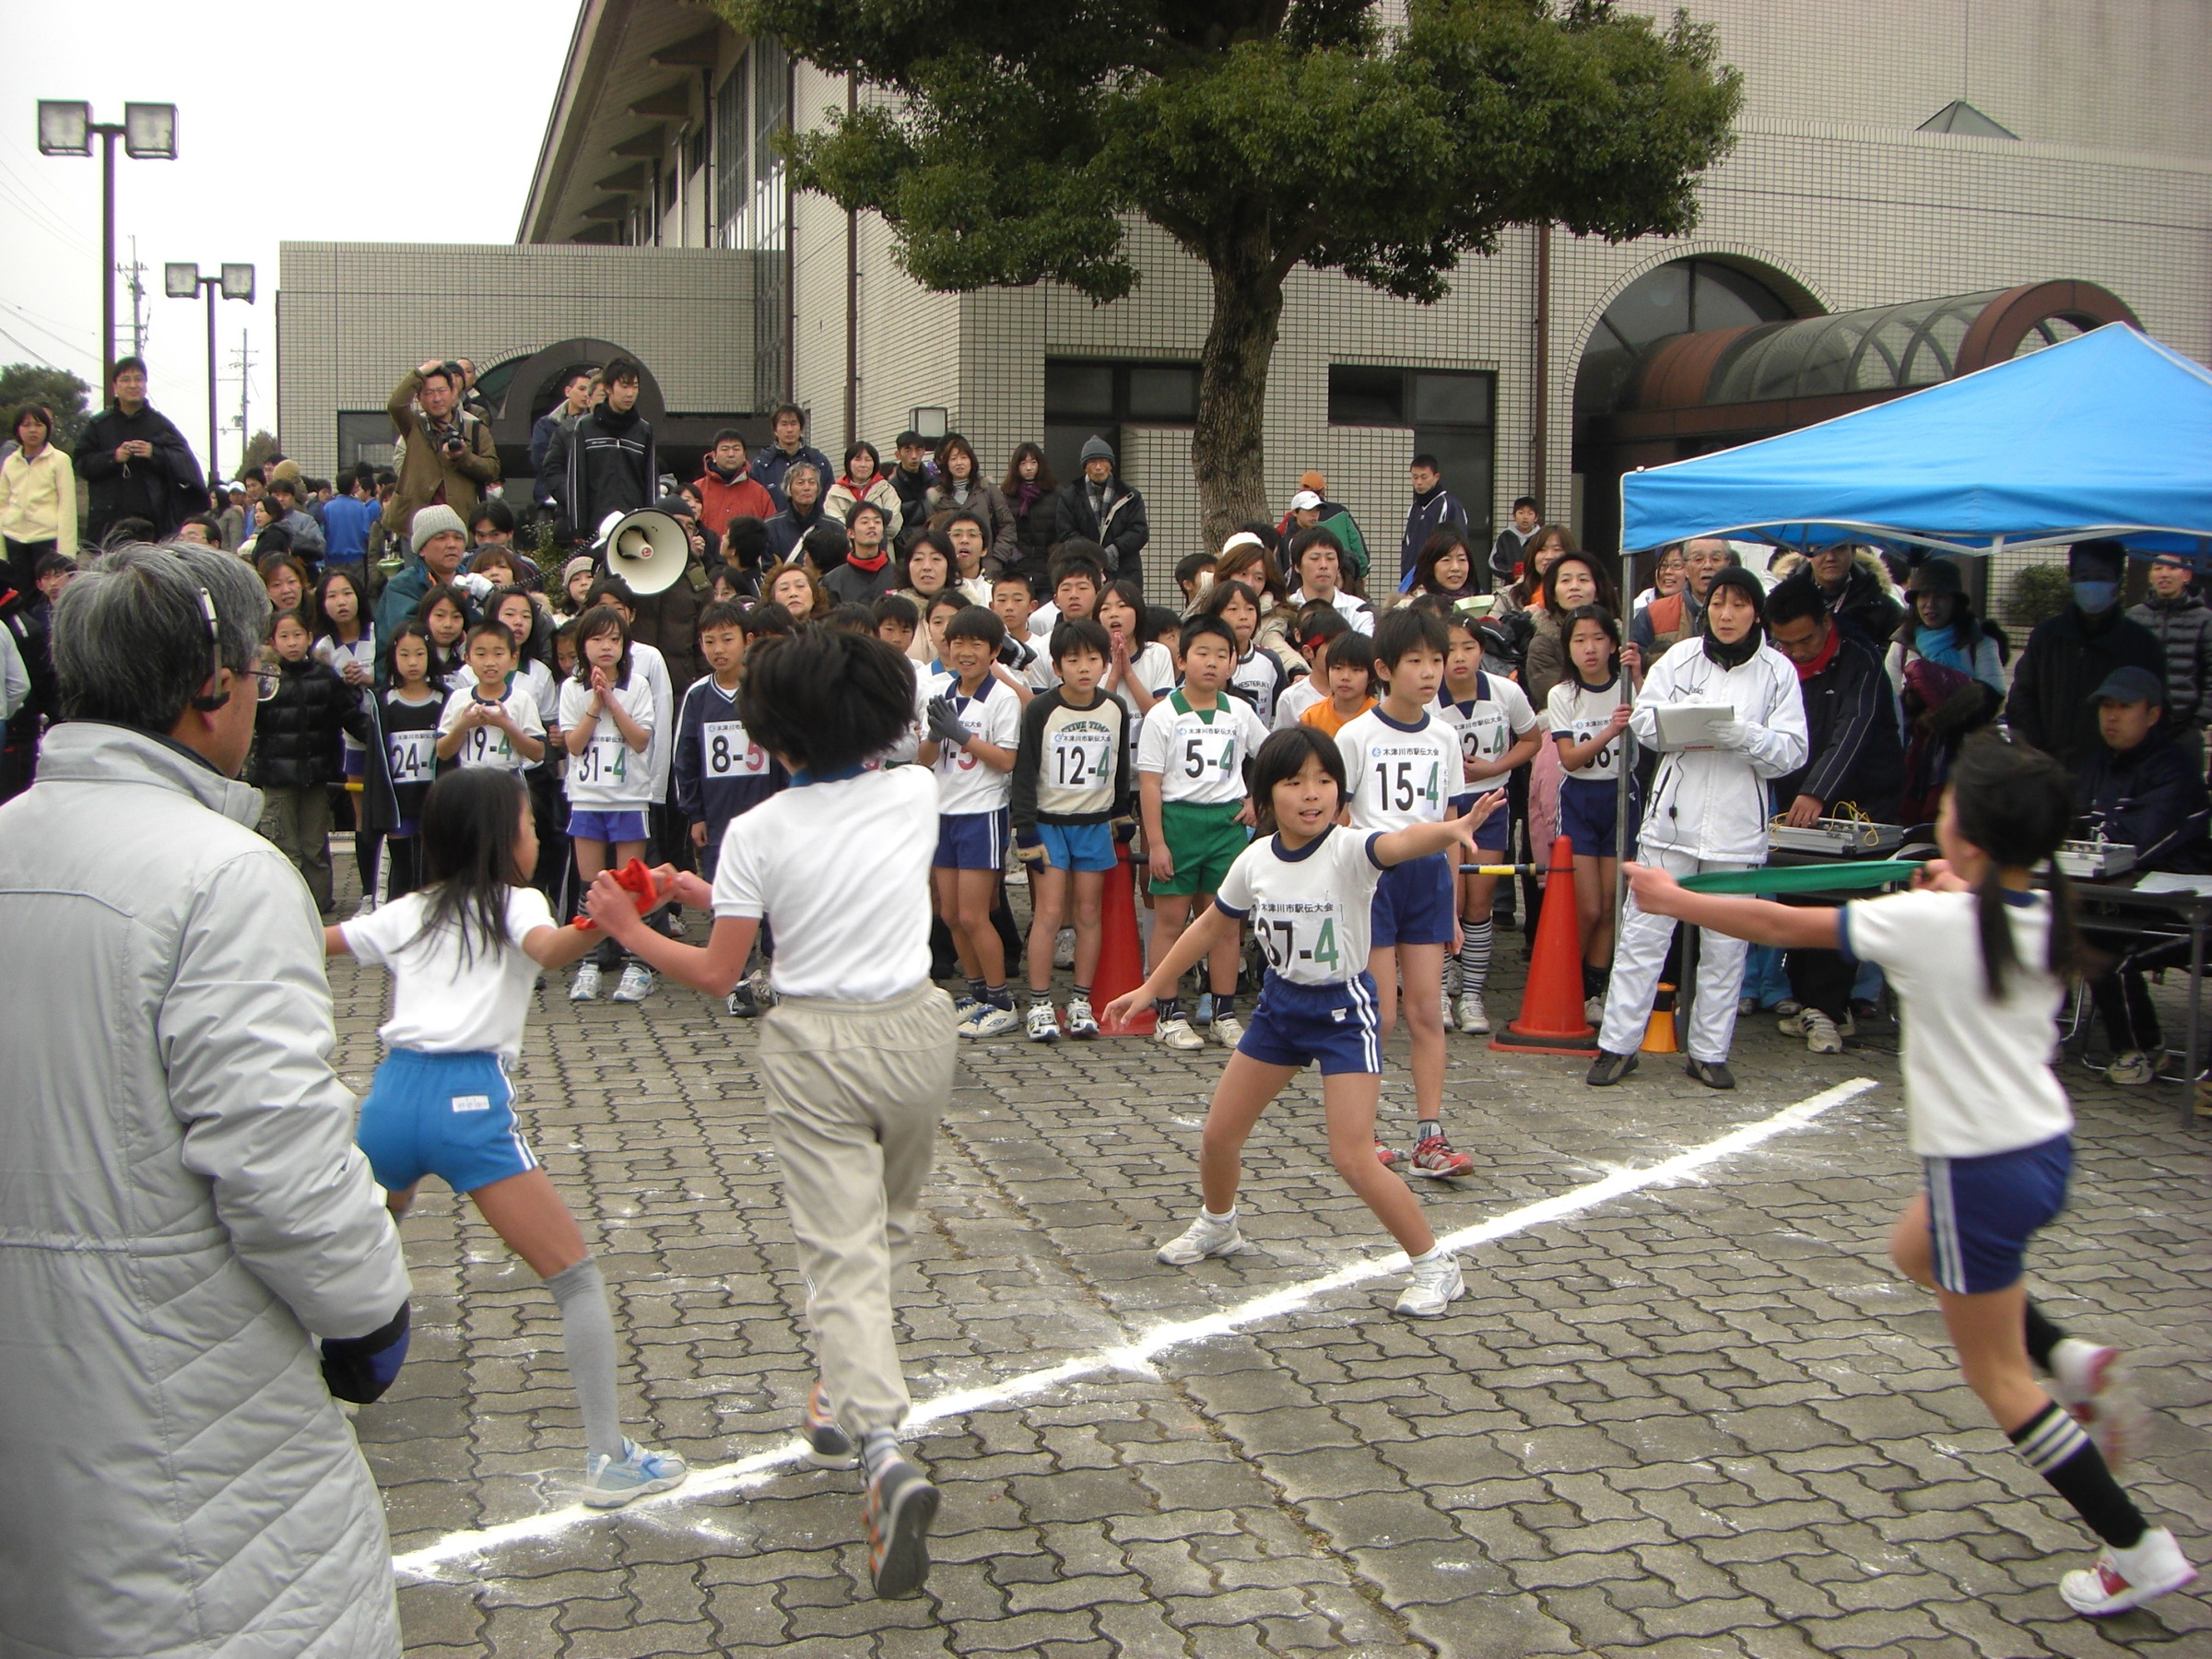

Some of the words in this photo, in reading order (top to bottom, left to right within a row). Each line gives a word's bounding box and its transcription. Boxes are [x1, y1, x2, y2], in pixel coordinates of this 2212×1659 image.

[1585, 719, 1612, 727] 木津川市
[579, 746, 627, 783] 31-4
[712, 735, 765, 773] 8-5
[1055, 745, 1111, 785] 12-4
[1184, 738, 1236, 779] 5-4
[1382, 747, 1440, 757] 木津川市駅伝大会
[1375, 761, 1440, 812] 15-4
[1261, 902, 1335, 913] 木津川市駅伝大会
